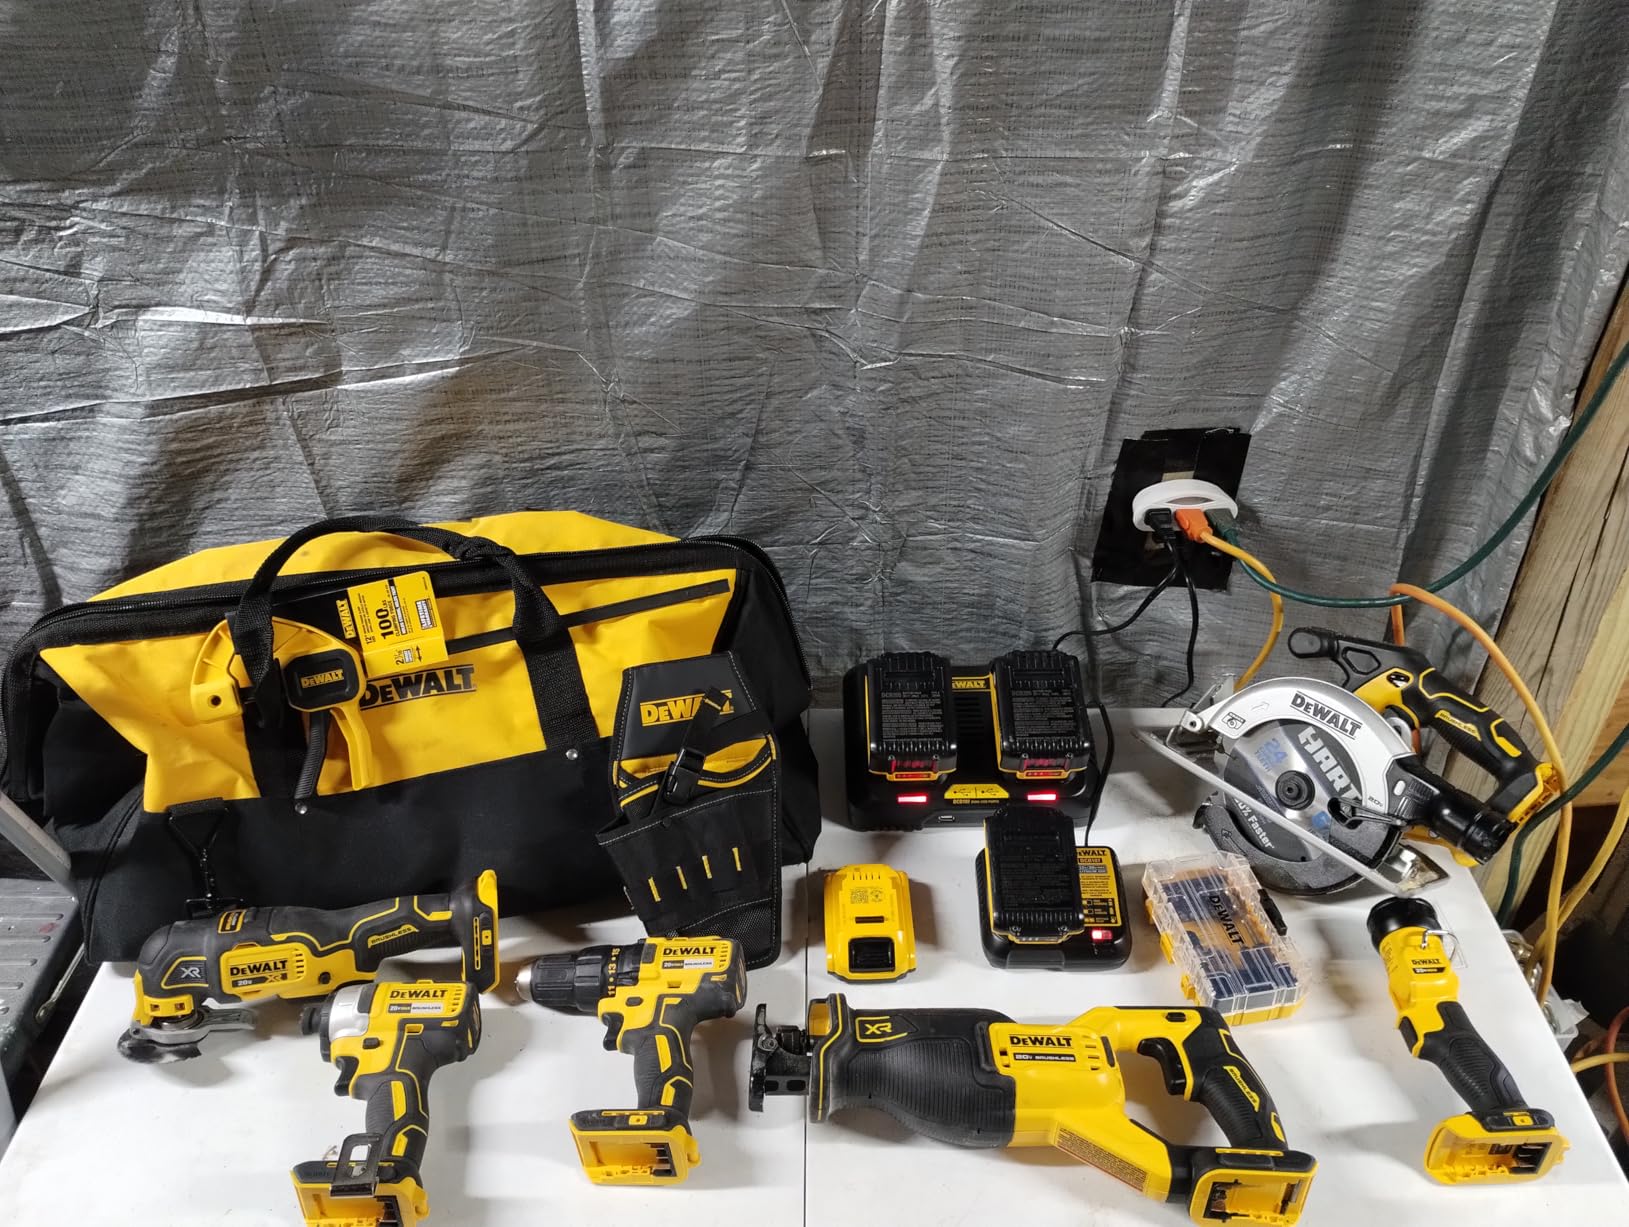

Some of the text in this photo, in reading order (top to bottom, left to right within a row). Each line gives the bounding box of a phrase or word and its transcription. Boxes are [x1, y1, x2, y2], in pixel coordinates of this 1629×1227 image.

[376, 608, 394, 639] 100
[302, 669, 344, 688] DEWALT
[360, 667, 474, 706] DEWALT
[1290, 692, 1362, 738] DEWALT
[1210, 894, 1244, 945] DEWALT
[662, 946, 716, 956] DEWALT
[181, 966, 201, 978] XR
[230, 960, 288, 976] DEWALT
[608, 964, 616, 975] 13
[390, 990, 448, 998] DEWALT
[864, 1022, 892, 1035] XR
[1010, 1036, 1072, 1046] DEWALT
